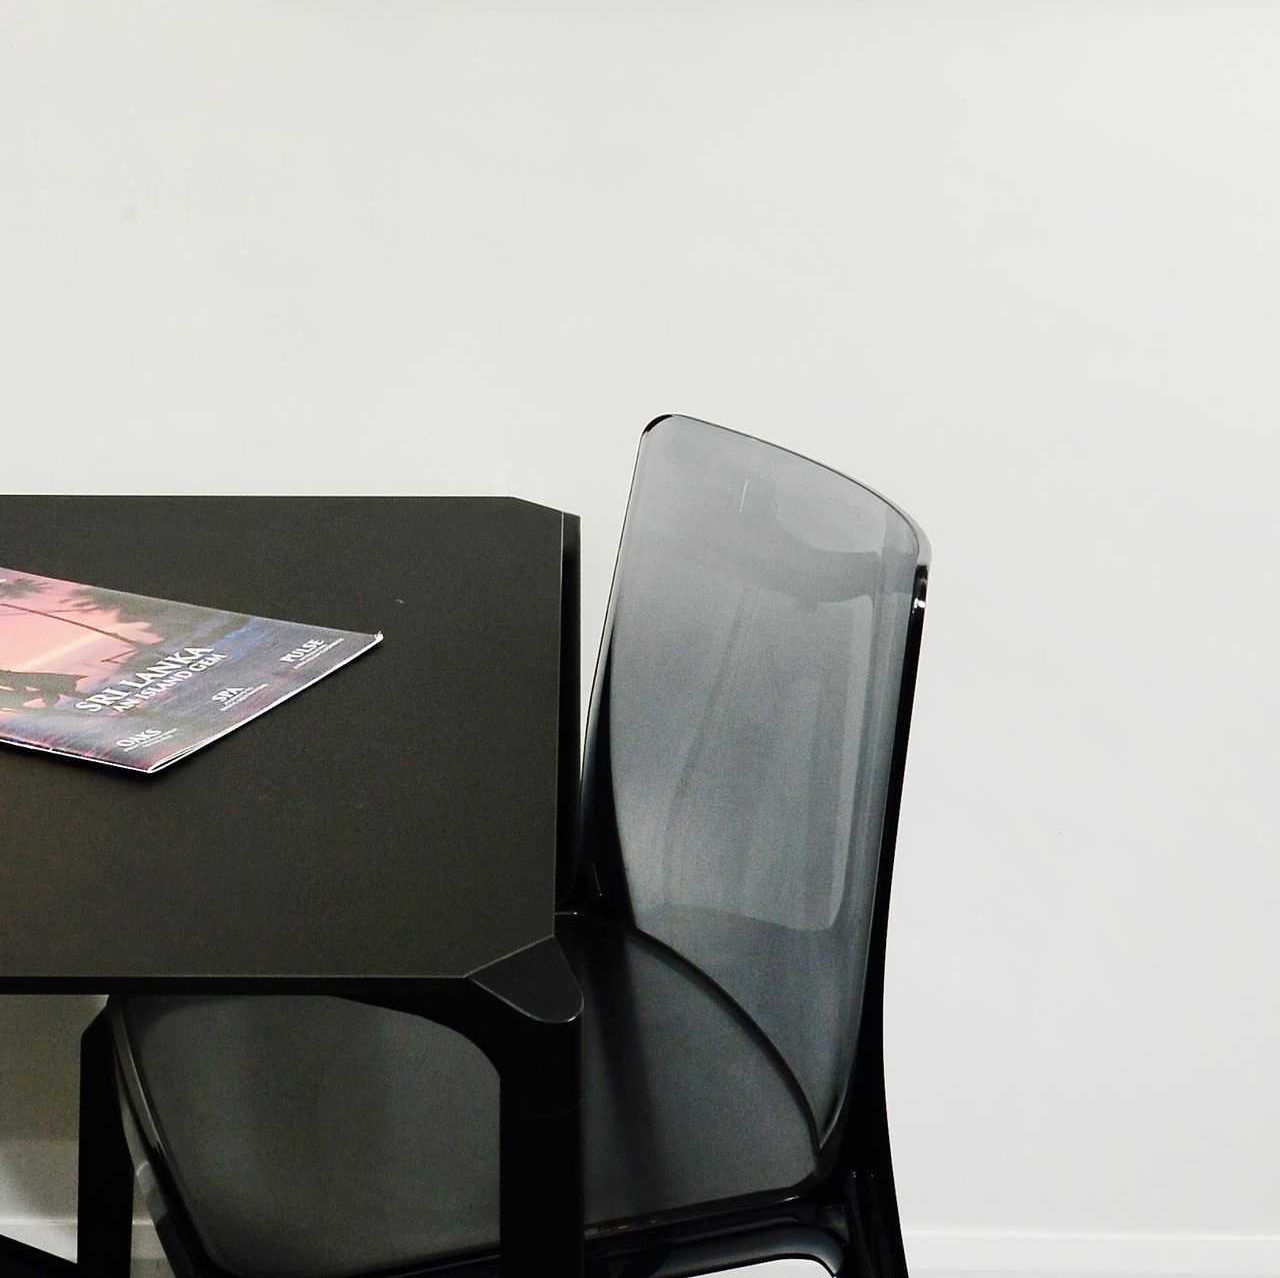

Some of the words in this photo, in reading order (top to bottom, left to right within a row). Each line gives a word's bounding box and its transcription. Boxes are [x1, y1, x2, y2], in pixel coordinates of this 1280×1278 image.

[280, 639, 325, 662] PULSE
[75, 679, 132, 712] SRI
[132, 646, 215, 688] LANKA
[112, 697, 141, 713] AN
[135, 670, 193, 700] ISLAND
[188, 653, 228, 672] GEM
[211, 687, 244, 702] SPA
[116, 728, 162, 746] OAKS
